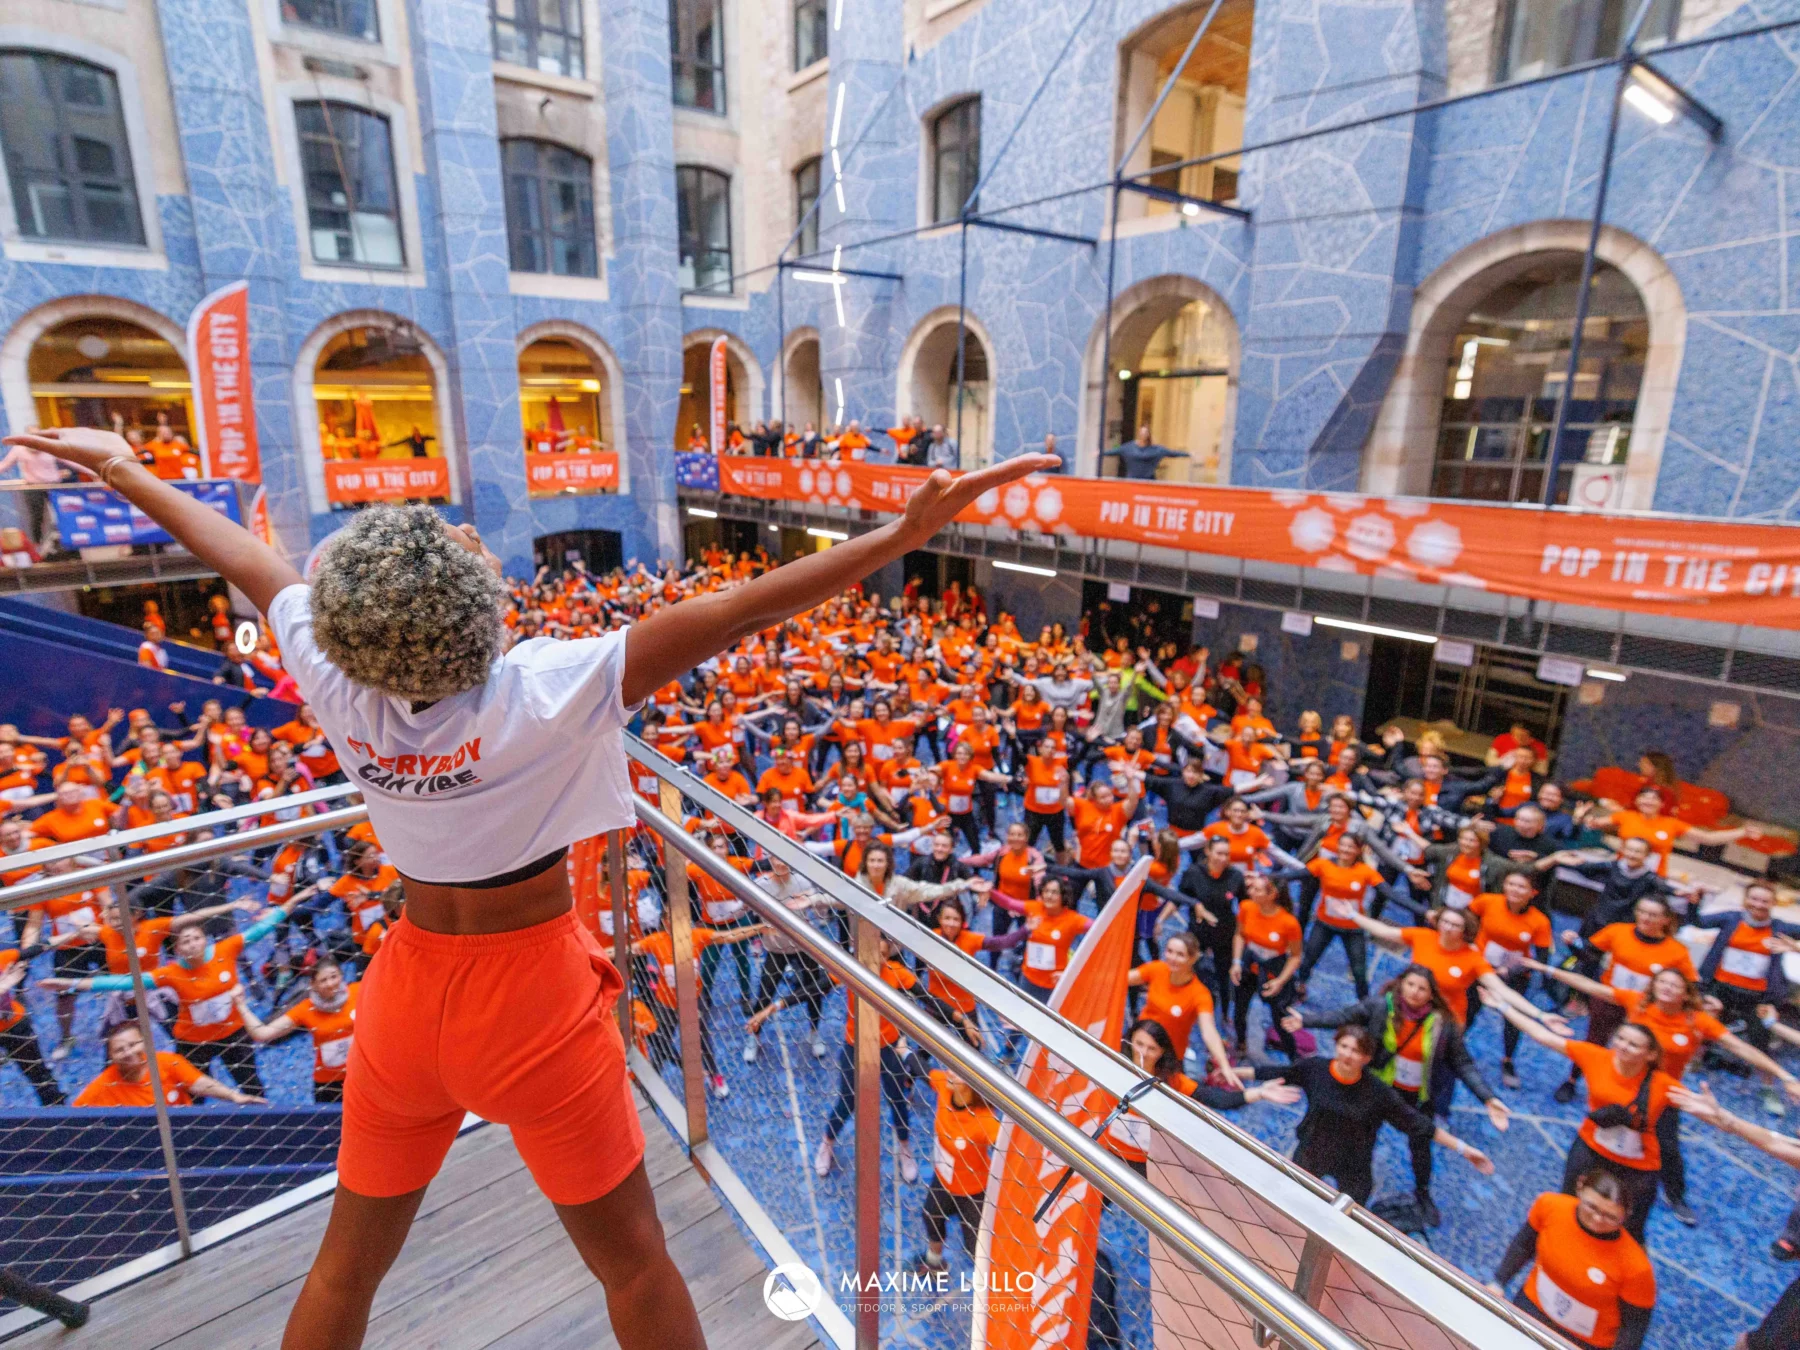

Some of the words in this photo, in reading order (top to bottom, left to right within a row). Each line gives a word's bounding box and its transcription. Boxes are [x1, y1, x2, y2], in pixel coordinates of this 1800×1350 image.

[209, 312, 240, 358] CITY
[212, 361, 241, 401] THE
[219, 426, 249, 465] POP
[1100, 501, 1129, 523] POP
[1133, 504, 1151, 527] IN
[1157, 506, 1188, 531] THE
[1193, 510, 1235, 536] CITY
[1540, 544, 1601, 578] POP
[1611, 551, 1649, 584] IN
[1663, 555, 1733, 593] THE
[358, 762, 416, 794] CAN
[413, 769, 478, 795] VIBE
